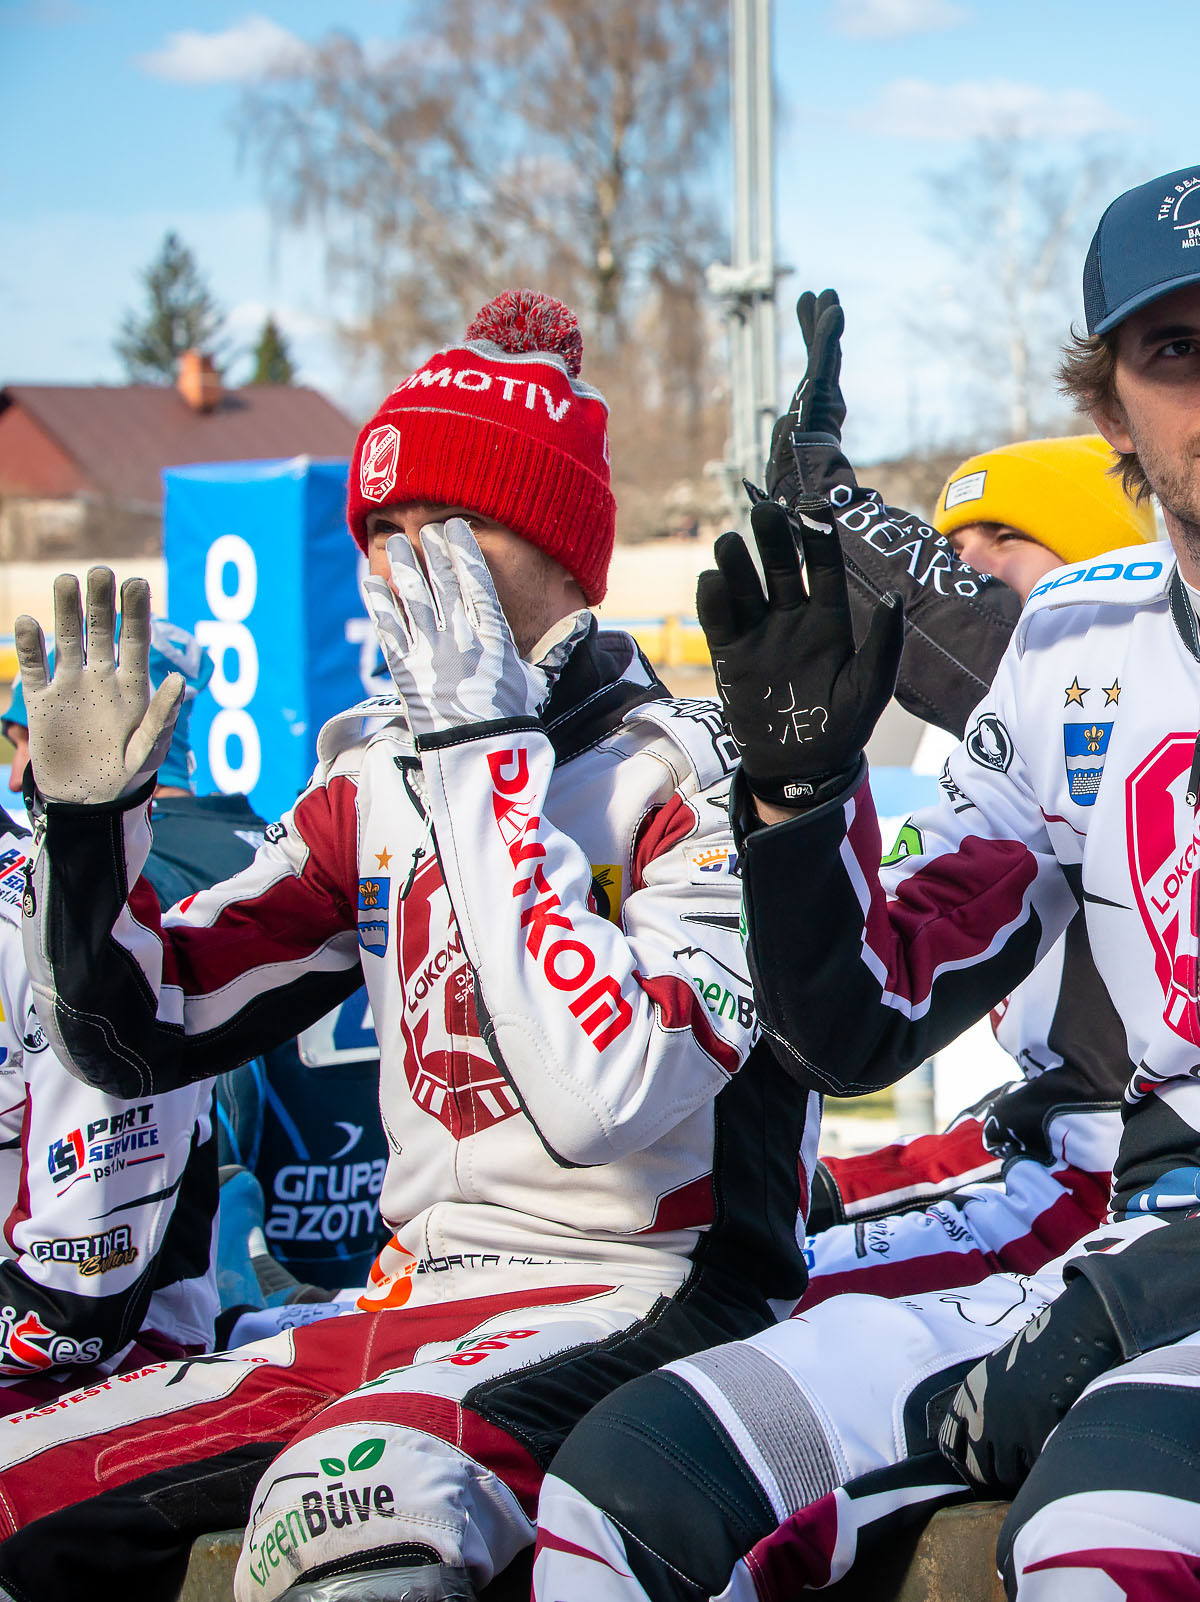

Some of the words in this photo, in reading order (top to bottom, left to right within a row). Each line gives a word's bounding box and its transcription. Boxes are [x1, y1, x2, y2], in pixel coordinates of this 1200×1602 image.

[1157, 196, 1175, 221] THE
[87, 1103, 154, 1143] PART
[88, 1128, 160, 1164] SERVICE
[31, 1226, 131, 1264] GORINA
[9, 1382, 113, 1426] FASTEST
[118, 1362, 169, 1383] WAY
